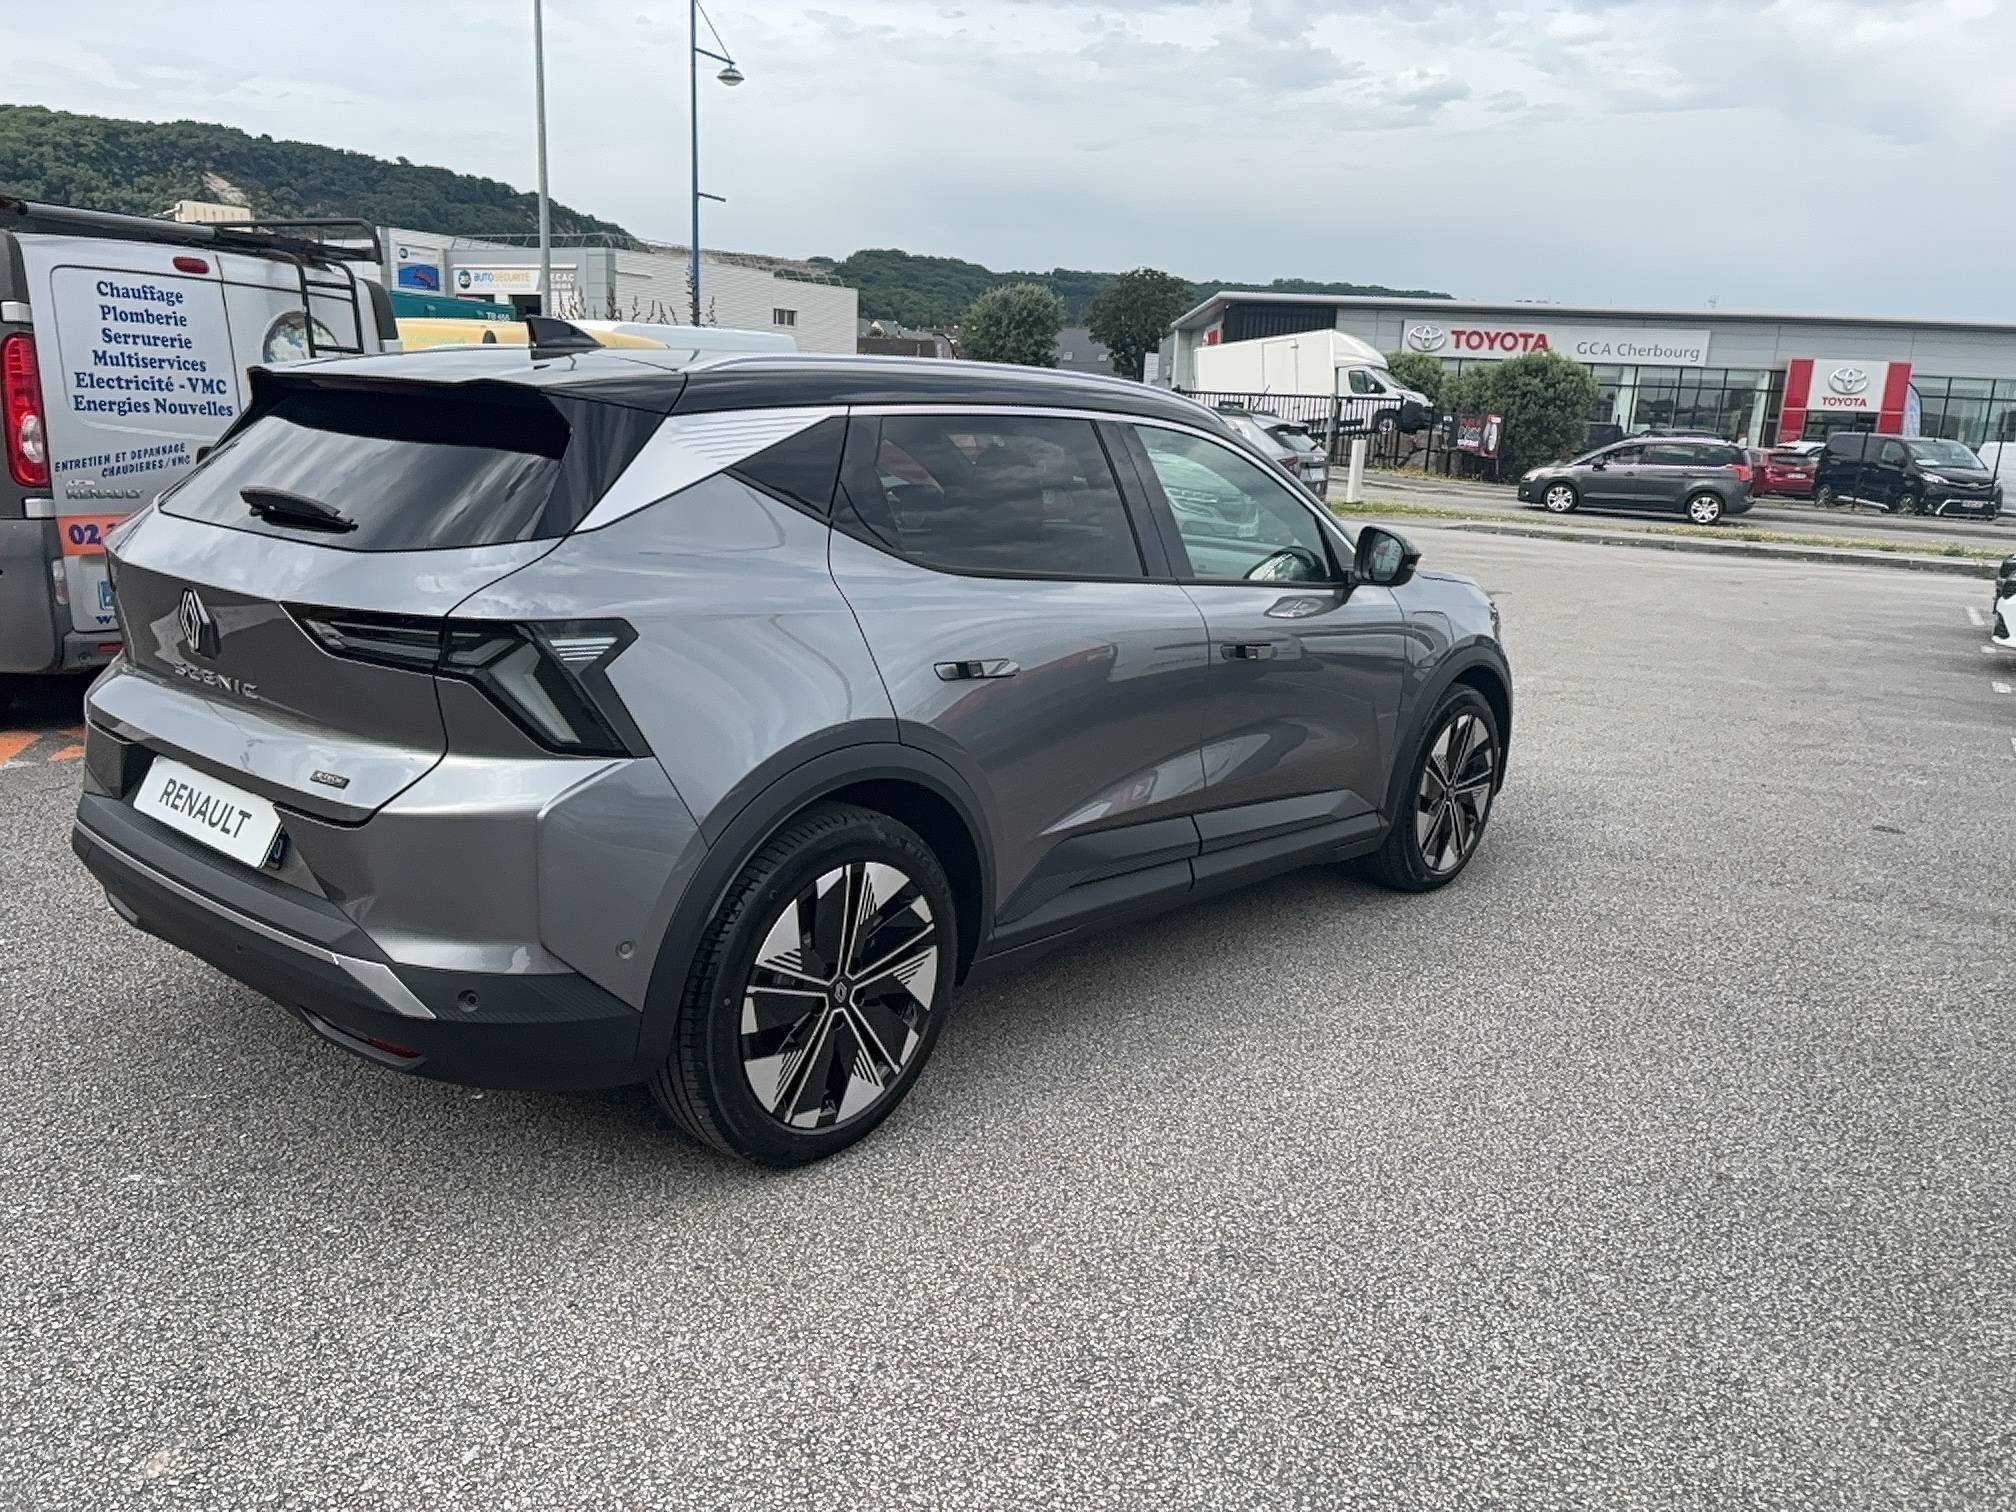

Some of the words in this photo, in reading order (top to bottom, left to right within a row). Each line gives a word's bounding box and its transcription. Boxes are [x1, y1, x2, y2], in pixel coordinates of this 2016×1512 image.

[96, 281, 184, 307] Chauffage
[99, 305, 187, 327] Plomberie
[101, 327, 192, 349] Serrurerie
[1451, 330, 1550, 351] TOYOTA
[92, 349, 207, 372] Multiservices
[1577, 341, 1611, 356] GCA
[1617, 343, 1700, 362] Cherbourg
[74, 372, 175, 392] Electricité
[187, 377, 227, 395] VMC
[73, 395, 150, 417] Energies
[153, 398, 234, 417] Nouvelles
[1822, 396, 1867, 407] TOYOTA
[54, 453, 111, 473] ENTRETIEN
[115, 451, 127, 463] ET
[131, 442, 185, 460] DEPANNAGE
[66, 488, 143, 500] RENAULT
[175, 663, 259, 699] SCENIC
[159, 777, 253, 838] RENAULT
